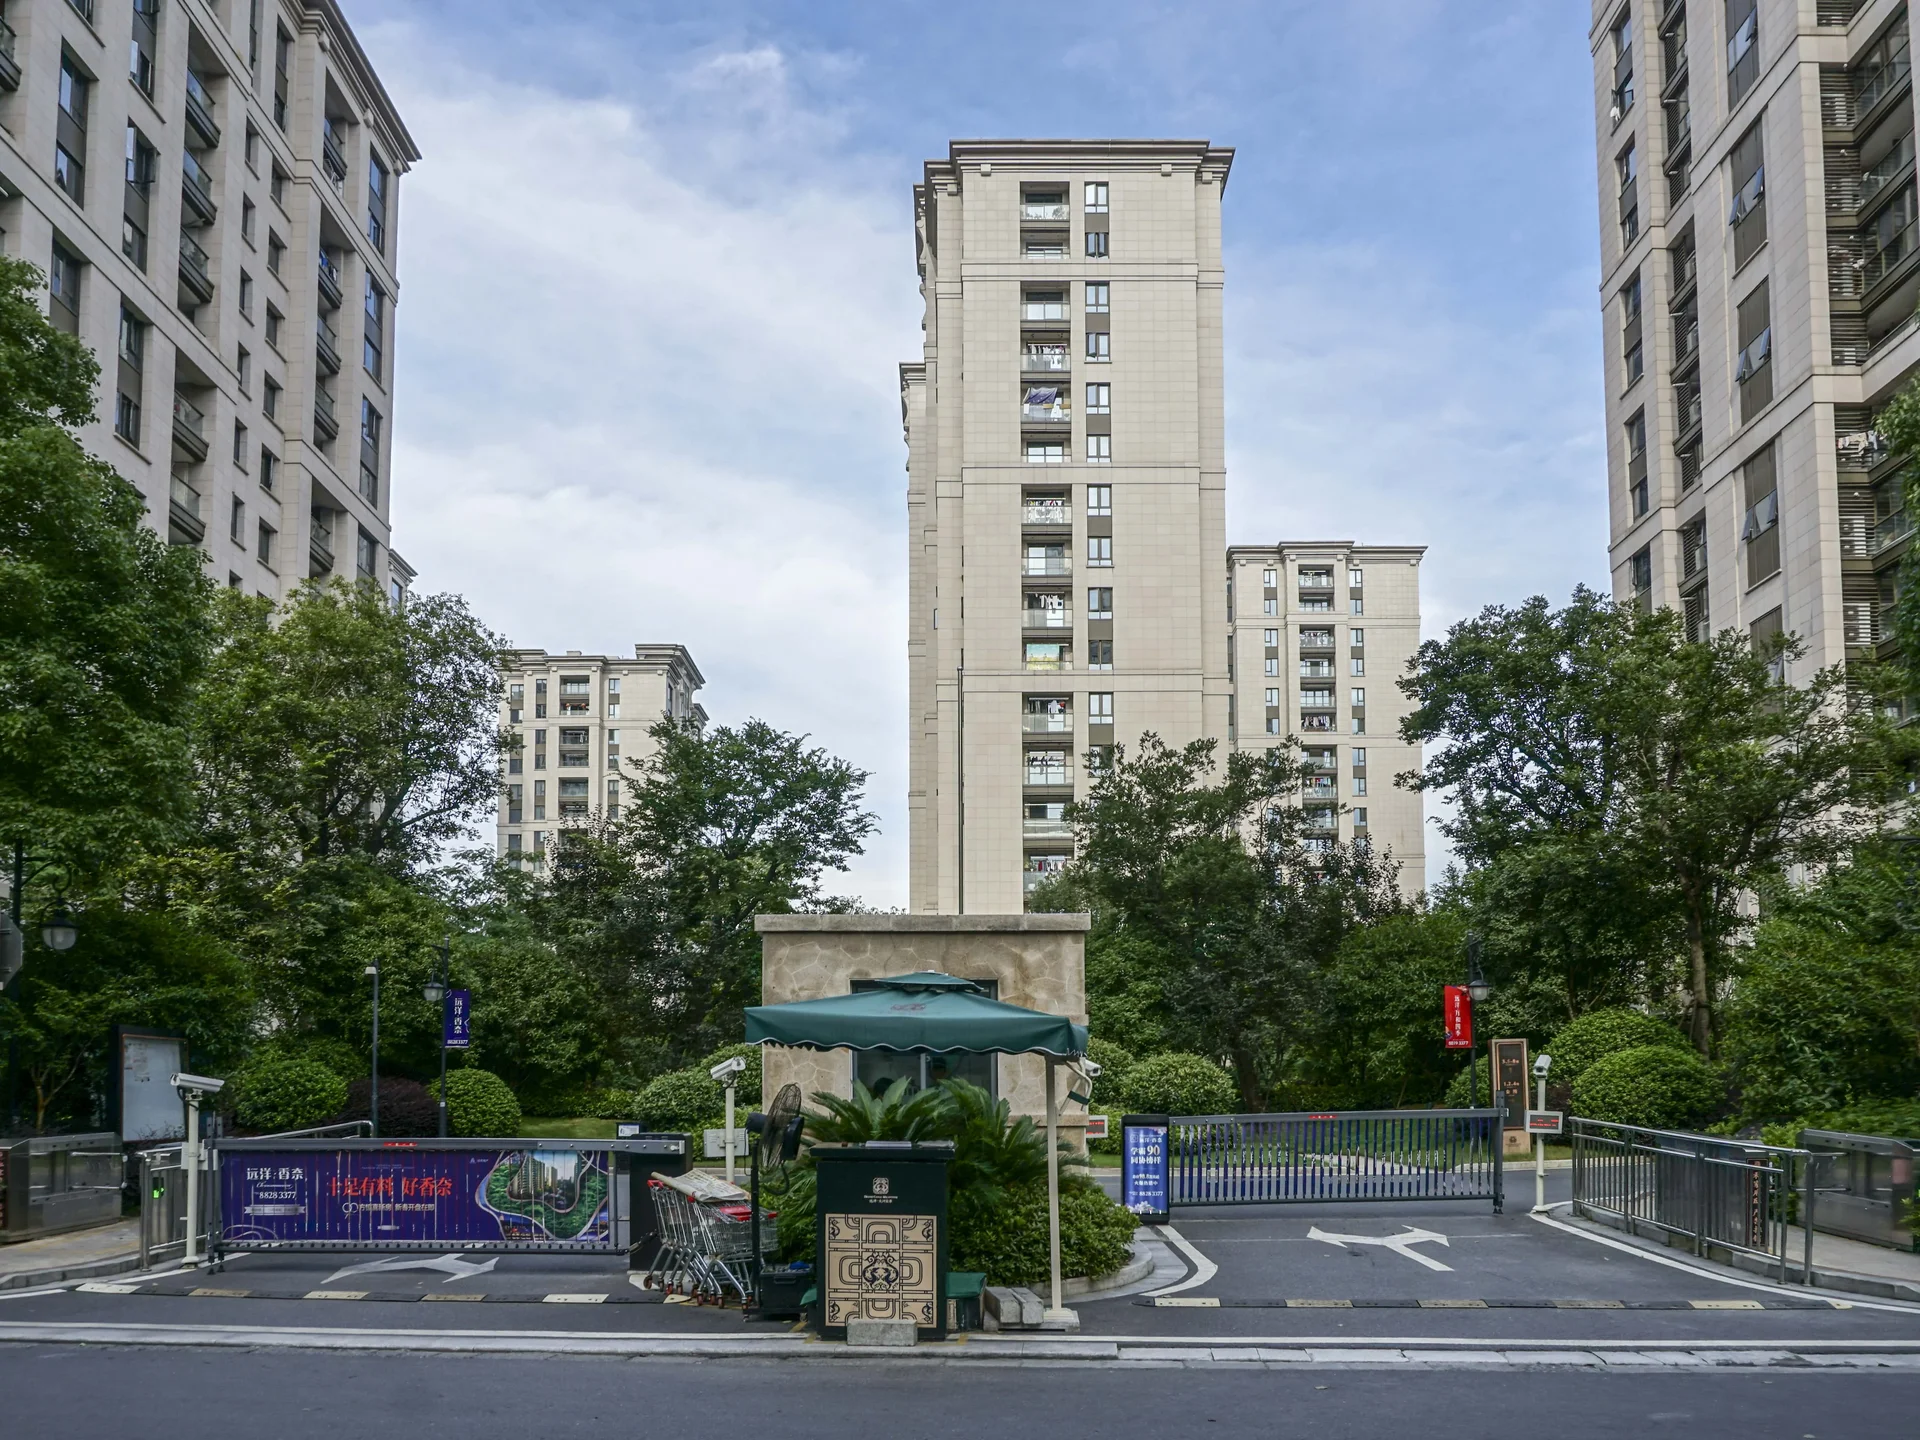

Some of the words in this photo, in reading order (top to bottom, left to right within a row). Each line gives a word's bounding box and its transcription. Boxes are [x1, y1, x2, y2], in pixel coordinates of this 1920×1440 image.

[246, 1167, 304, 1181] 远洋·香奈
[329, 1176, 394, 1197] 十足有料
[402, 1176, 453, 1197] 好香奈
[259, 1191, 278, 1199] 8828
[278, 1191, 296, 1199] 3377
